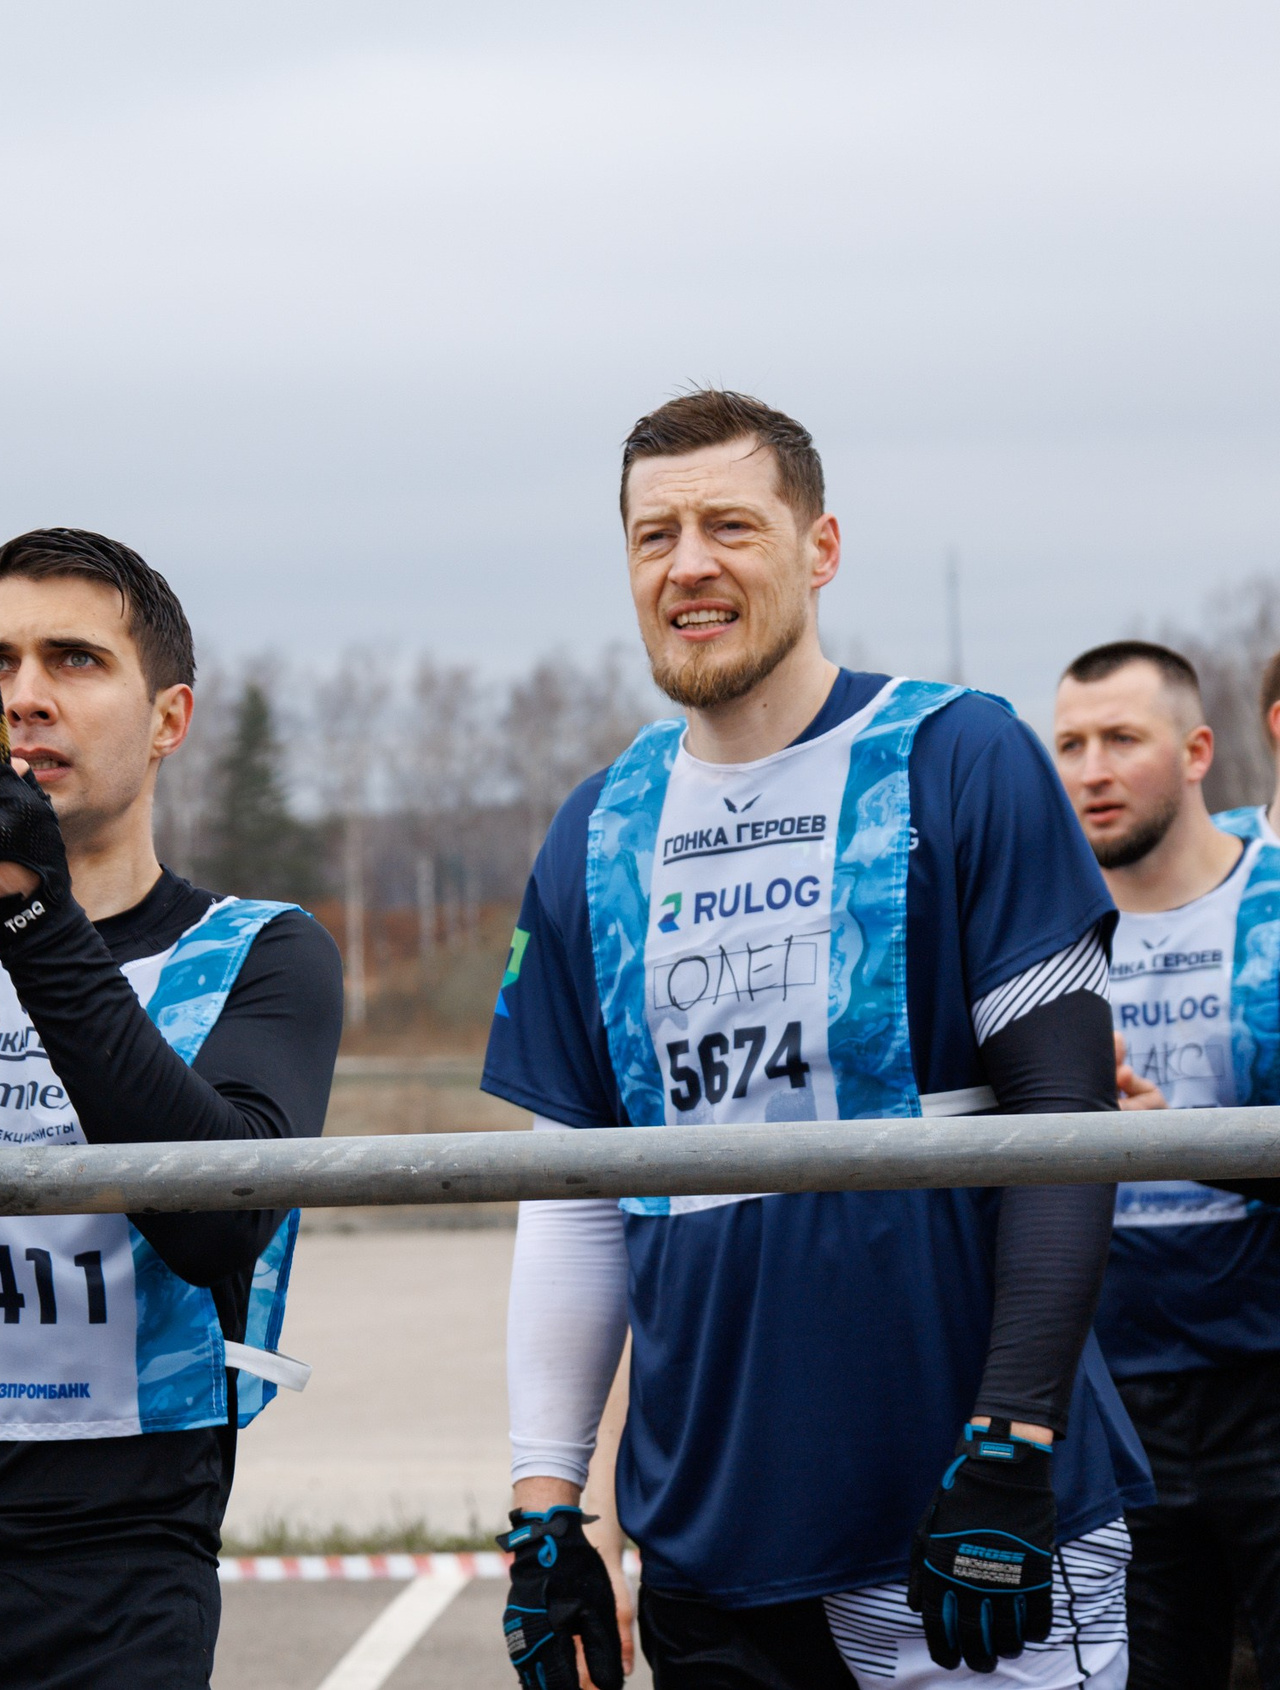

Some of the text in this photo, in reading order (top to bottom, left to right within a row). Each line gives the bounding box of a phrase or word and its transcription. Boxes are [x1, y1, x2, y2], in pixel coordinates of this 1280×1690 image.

[663, 814, 827, 858] ГОНКА ГЕРОЕВ
[4, 900, 46, 934] TORQ
[693, 875, 821, 924] RULOG
[667, 928, 832, 1010] ОЛЕГ
[1152, 949, 1223, 968] ГЕРОЕВ
[1120, 993, 1220, 1029] RULOG
[666, 1020, 811, 1112] 5674
[958, 1543, 1026, 1564] GROSS
